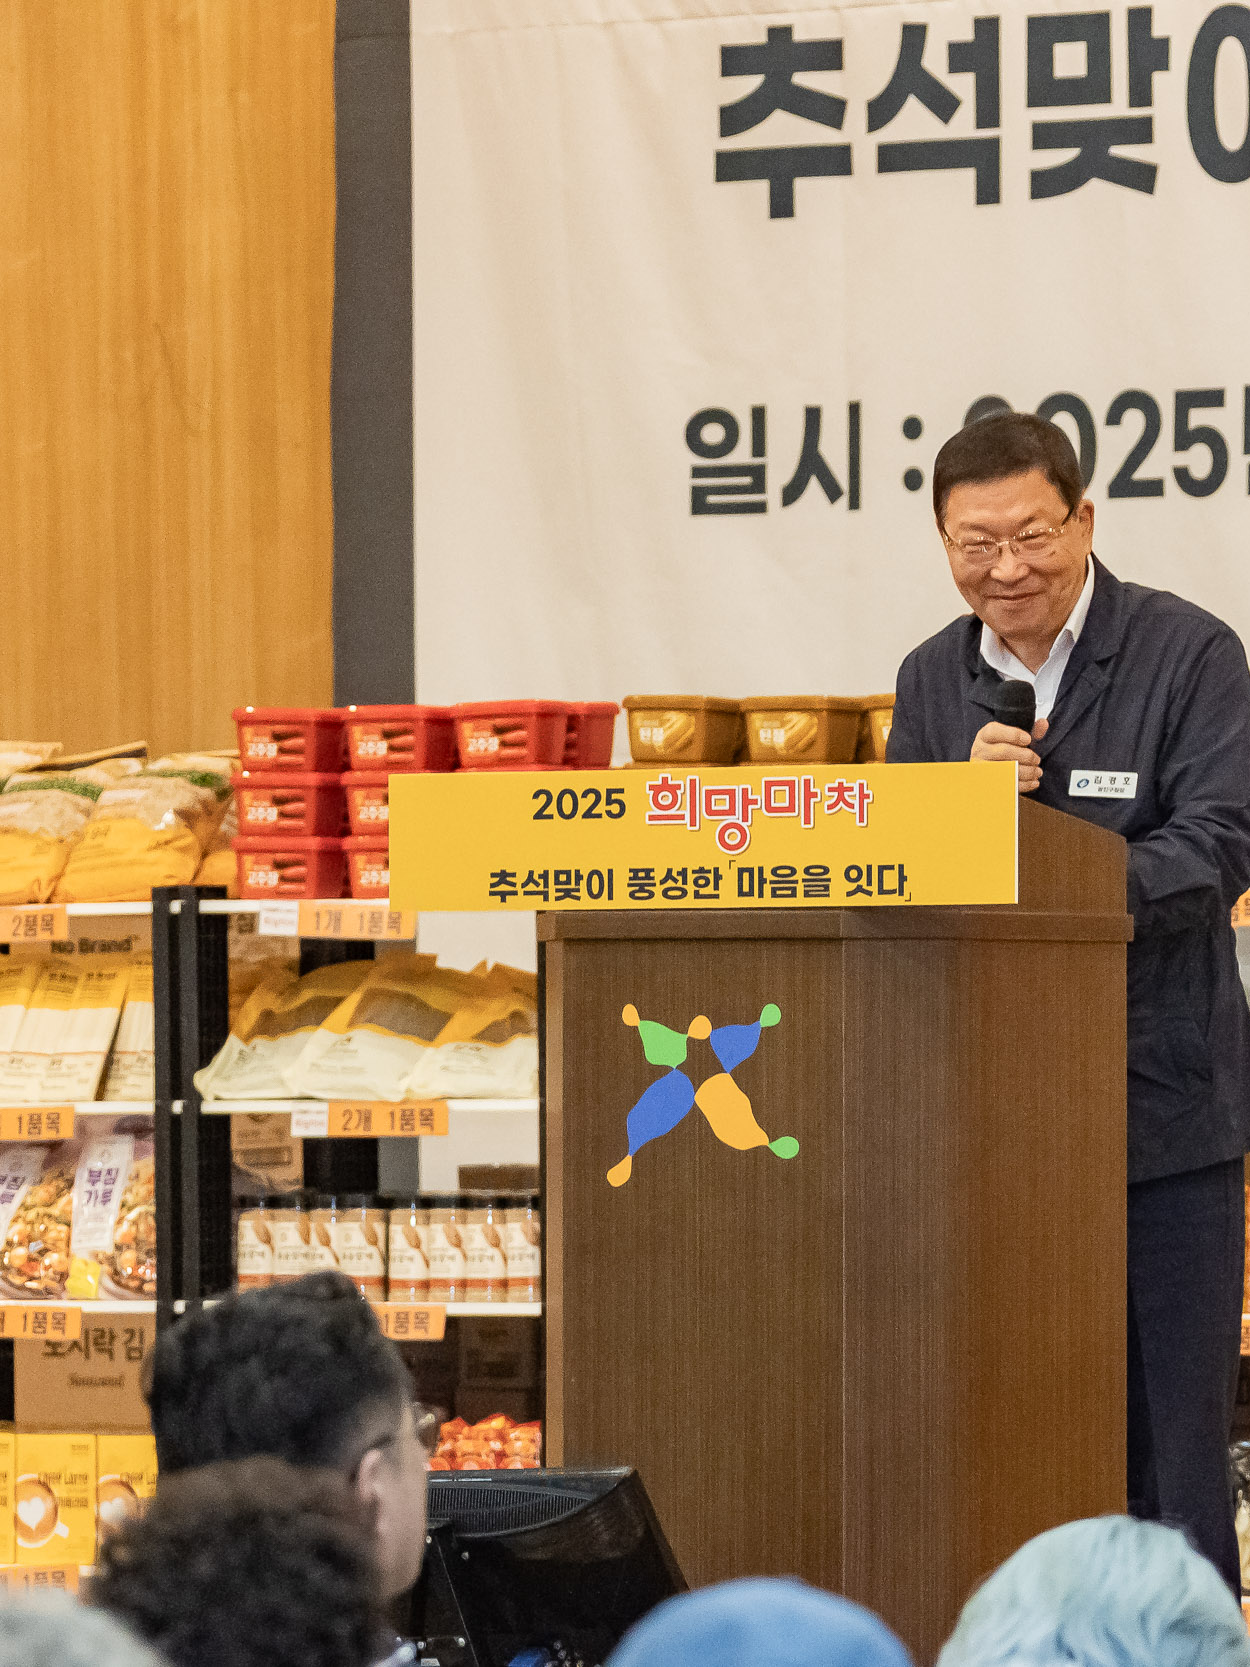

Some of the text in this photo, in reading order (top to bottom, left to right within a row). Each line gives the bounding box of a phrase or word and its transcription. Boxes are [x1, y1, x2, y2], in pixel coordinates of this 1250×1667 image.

[685, 401, 862, 515] 일시
[532, 773, 874, 855] 2025 희망마차
[488, 869, 615, 904] 추석맞이
[627, 866, 727, 901] 풍성한
[17, 1111, 61, 1136] 1품목
[343, 1108, 373, 1132] 2개
[389, 1108, 435, 1133] 1품목
[22, 1311, 66, 1337] 1품목
[124, 1326, 145, 1361] 김
